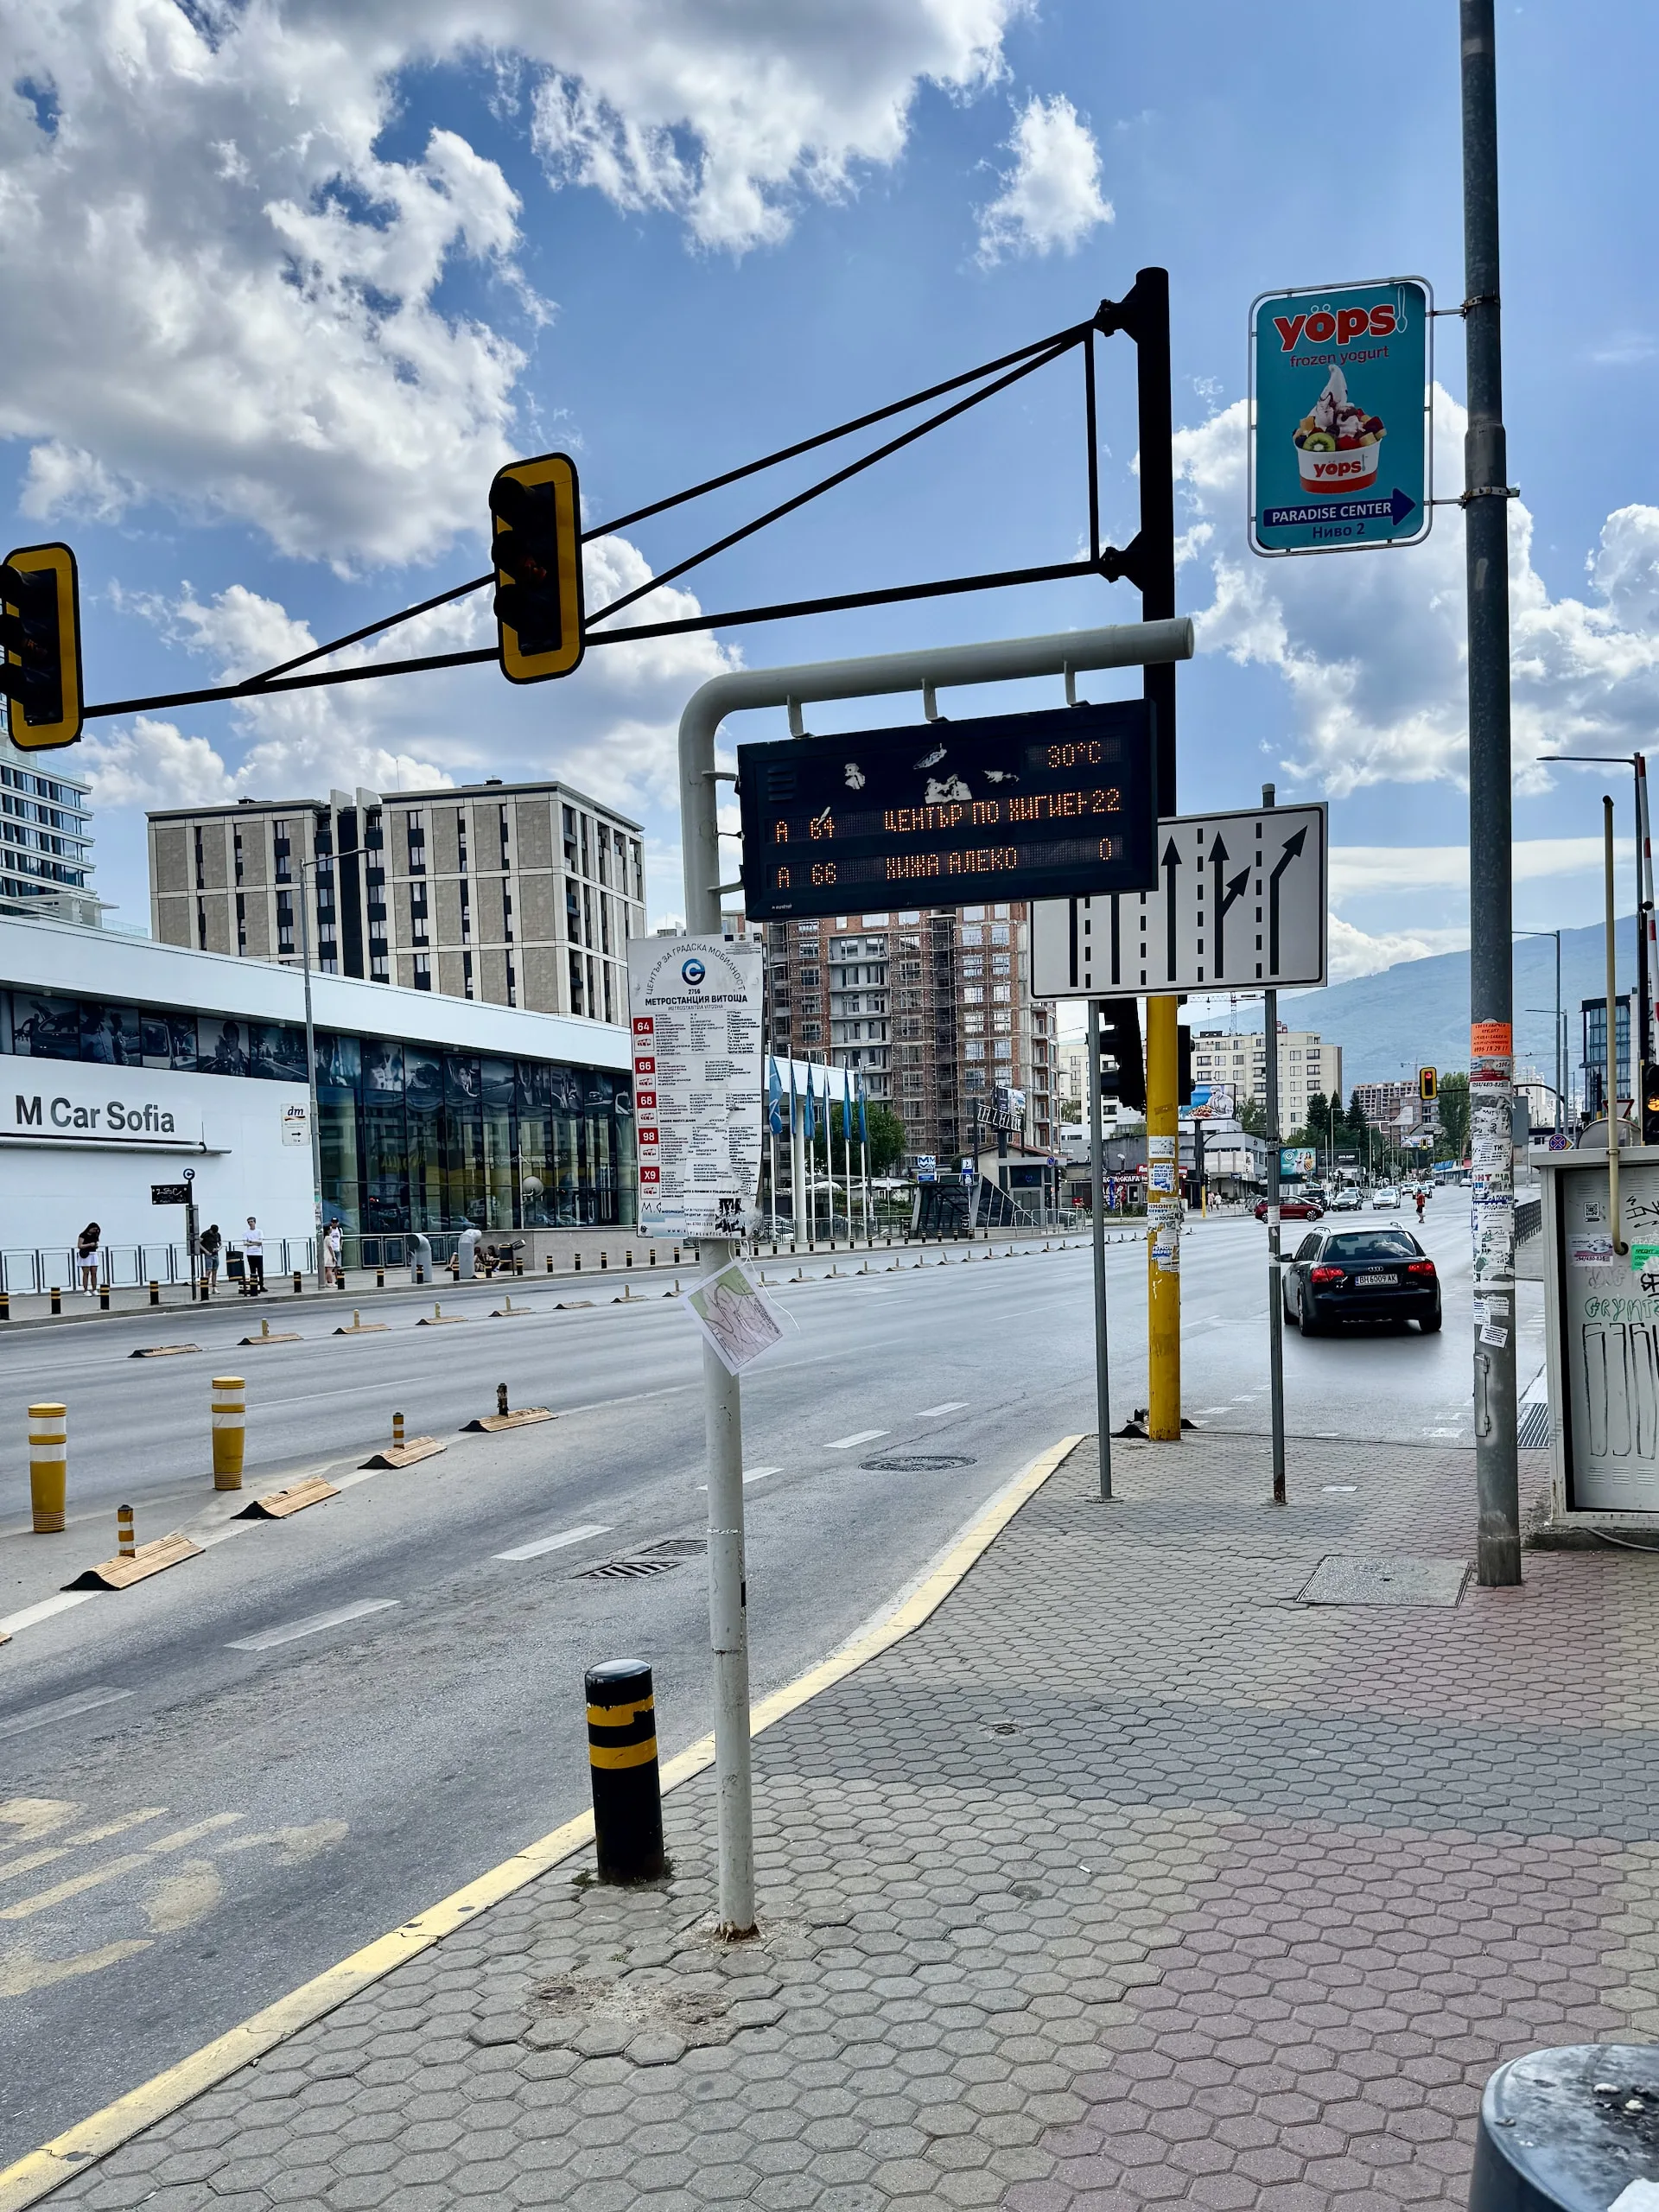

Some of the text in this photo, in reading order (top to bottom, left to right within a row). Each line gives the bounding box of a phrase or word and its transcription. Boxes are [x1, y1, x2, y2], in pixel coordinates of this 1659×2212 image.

[1290, 346, 1389, 367] frozen yogurt
[1272, 502, 1392, 523] PARADISE CENTER
[1313, 523, 1365, 538] Ниво 2
[1047, 741, 1102, 768] 30°C
[810, 817, 836, 841] 64
[884, 804, 963, 832] ЦЕНТЪР
[972, 800, 1000, 825] ПО
[1092, 788, 1121, 813] 22
[811, 862, 837, 885] 66
[886, 854, 939, 880] ХИЖА
[949, 847, 1018, 874] АЛЕКО
[1098, 837, 1113, 861] 0
[646, 960, 663, 995] ЦЕНТЪР
[661, 951, 673, 963] ЗА
[671, 943, 707, 957] ГРАДСКА
[708, 946, 746, 991] МОБИЛНОСТ
[645, 994, 748, 1006] МЕТРОСТАНЦИЯ ВИТОША
[637, 1022, 650, 1031] 64
[639, 1062, 652, 1071] 66
[640, 1096, 653, 1105] 68
[16, 1095, 175, 1133] M Car Sofia
[288, 1106, 303, 1116] dm
[643, 1132, 655, 1141] 98
